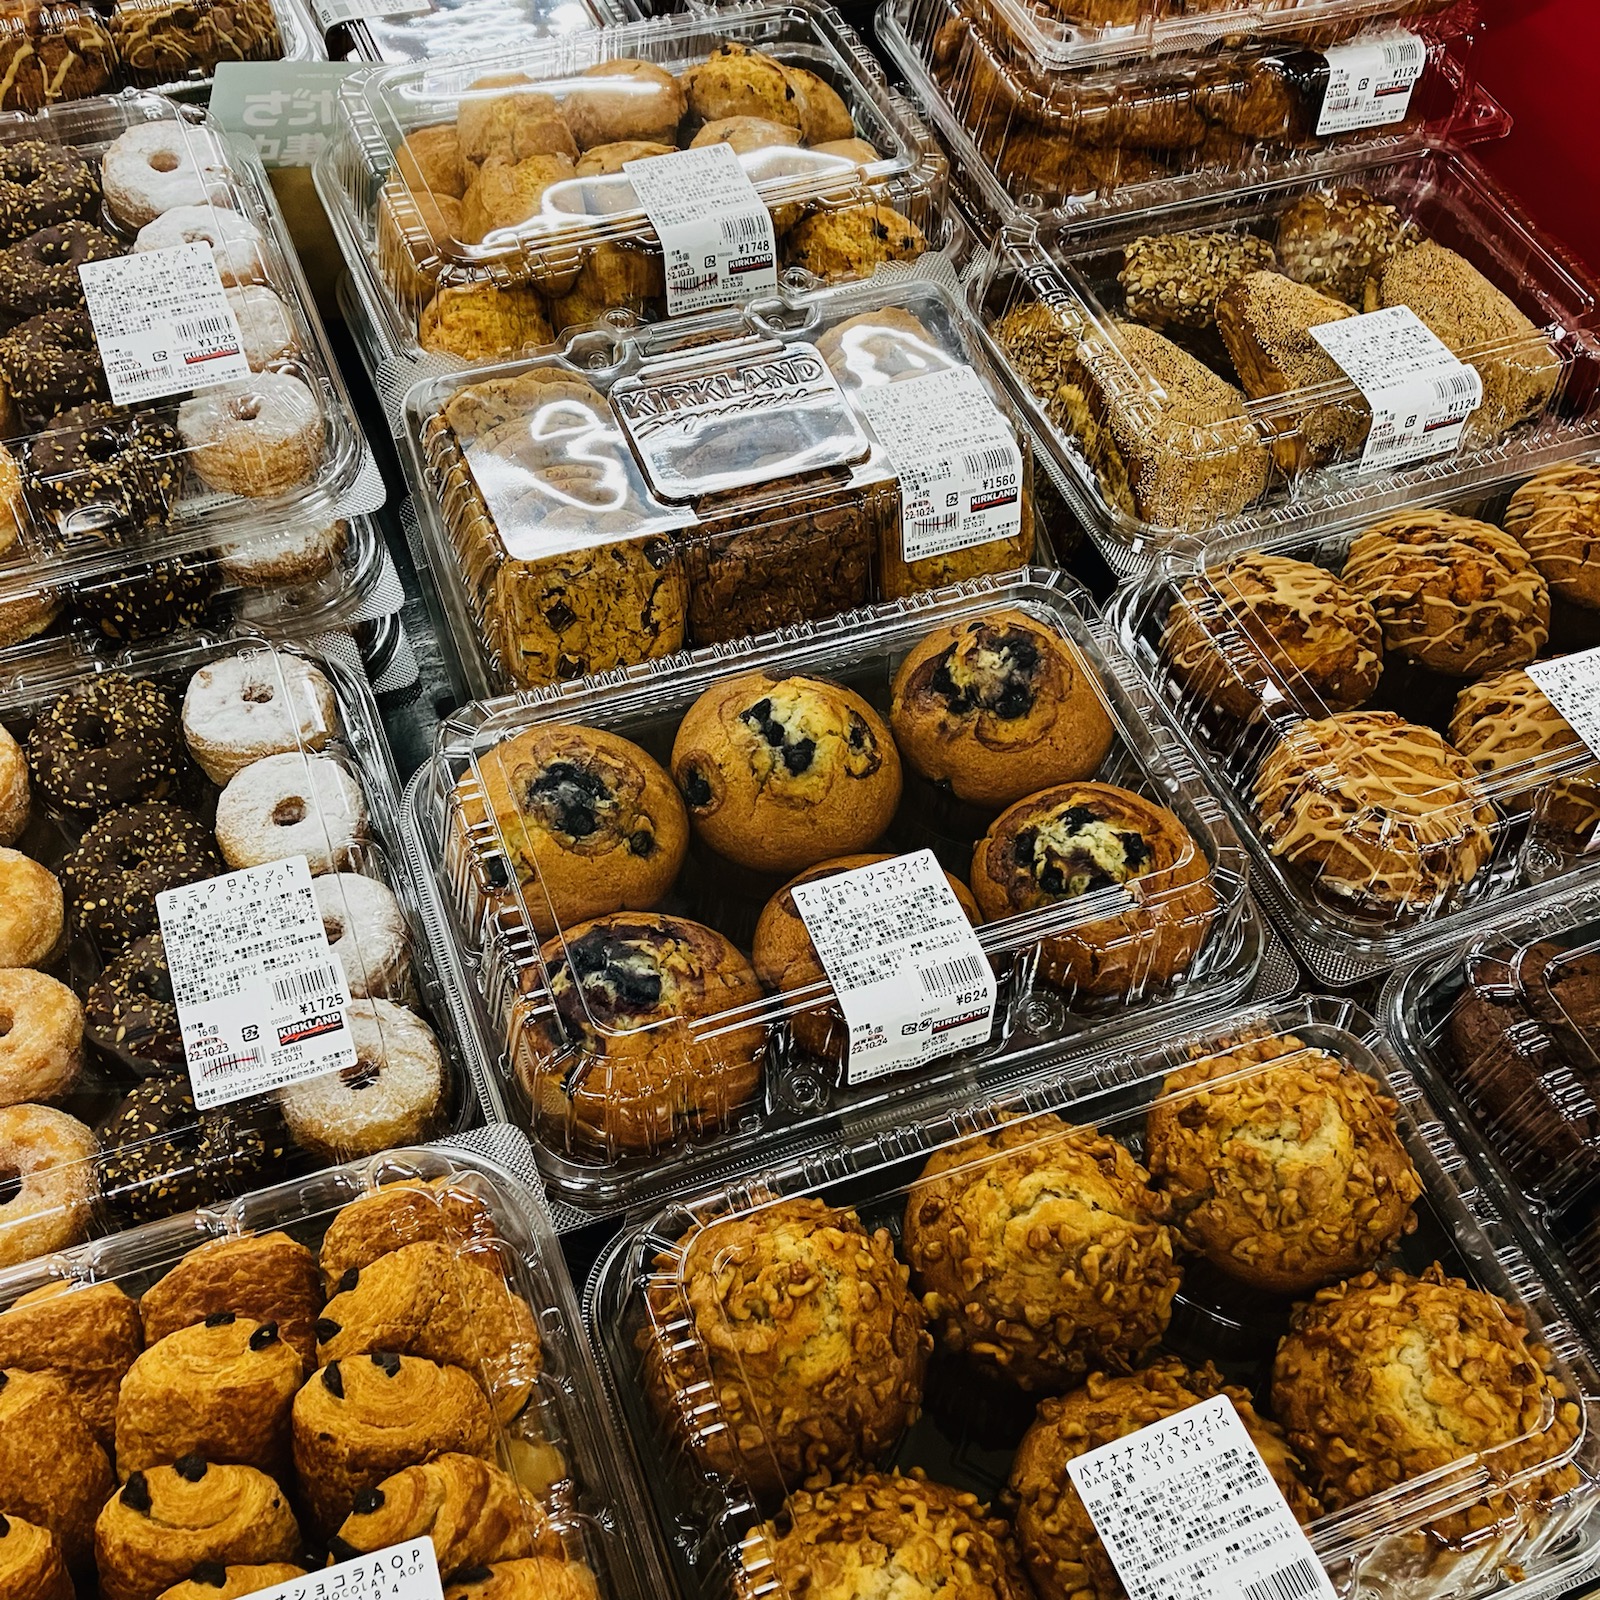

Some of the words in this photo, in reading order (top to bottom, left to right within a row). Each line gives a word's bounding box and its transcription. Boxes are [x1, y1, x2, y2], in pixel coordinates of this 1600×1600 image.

[1393, 65, 1419, 78] ¥1124
[738, 238, 769, 255] ¥1748
[729, 252, 772, 268] KIRKLAND
[198, 333, 235, 347] ¥1725
[184, 342, 238, 359] KIRKLAND
[618, 357, 824, 419] KIRKLAND
[1446, 396, 1478, 412] ¥1124
[982, 472, 1015, 491] ¥1560
[971, 486, 1016, 505] KIRKLAND
[905, 506, 934, 520] 22.10.24
[883, 865, 929, 882] MUFFIN
[168, 863, 293, 903] ミニクロドット
[298, 992, 344, 1015] ¥1725
[956, 985, 988, 1006] ¥624
[278, 1011, 340, 1037] KIRKLAND
[933, 1006, 989, 1028] KIRKLAND
[197, 1024, 219, 1038] 16個
[188, 1042, 229, 1062] 22.10.23
[272, 1051, 303, 1066] 22.10.21
[1076, 1405, 1226, 1480] バナナナッツマフィン
[1084, 1461, 1133, 1489] BANANA
[1141, 1443, 1174, 1463] NUTS
[1181, 1417, 1230, 1445] MUFFIN
[400, 1563, 425, 1579] AOP
